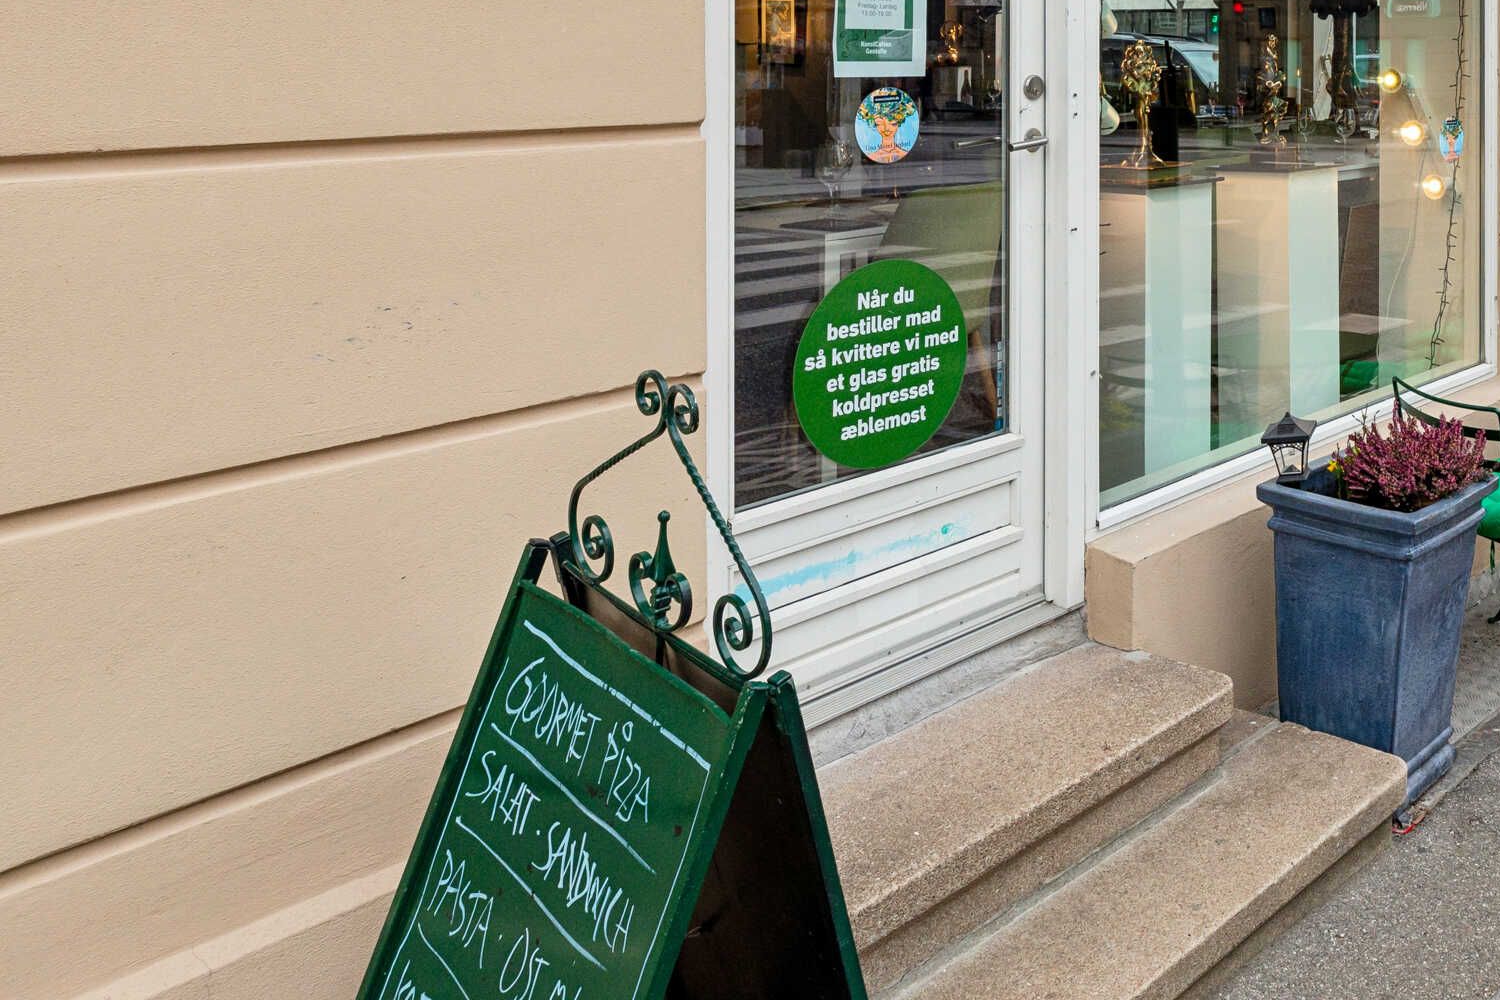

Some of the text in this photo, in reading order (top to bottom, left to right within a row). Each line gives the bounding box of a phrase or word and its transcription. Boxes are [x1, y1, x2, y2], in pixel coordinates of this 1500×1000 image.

[857, 286, 915, 311] Når du
[826, 305, 941, 342] bestiller mad
[804, 325, 959, 371] så kvittere vi med
[826, 356, 940, 393] et glas gratis
[832, 379, 935, 418] koldpresset
[840, 405, 927, 441] æblemost
[505, 656, 602, 777] GOURMET
[465, 750, 634, 954] SALAT SANDWICH
[426, 849, 494, 970] PASTA
